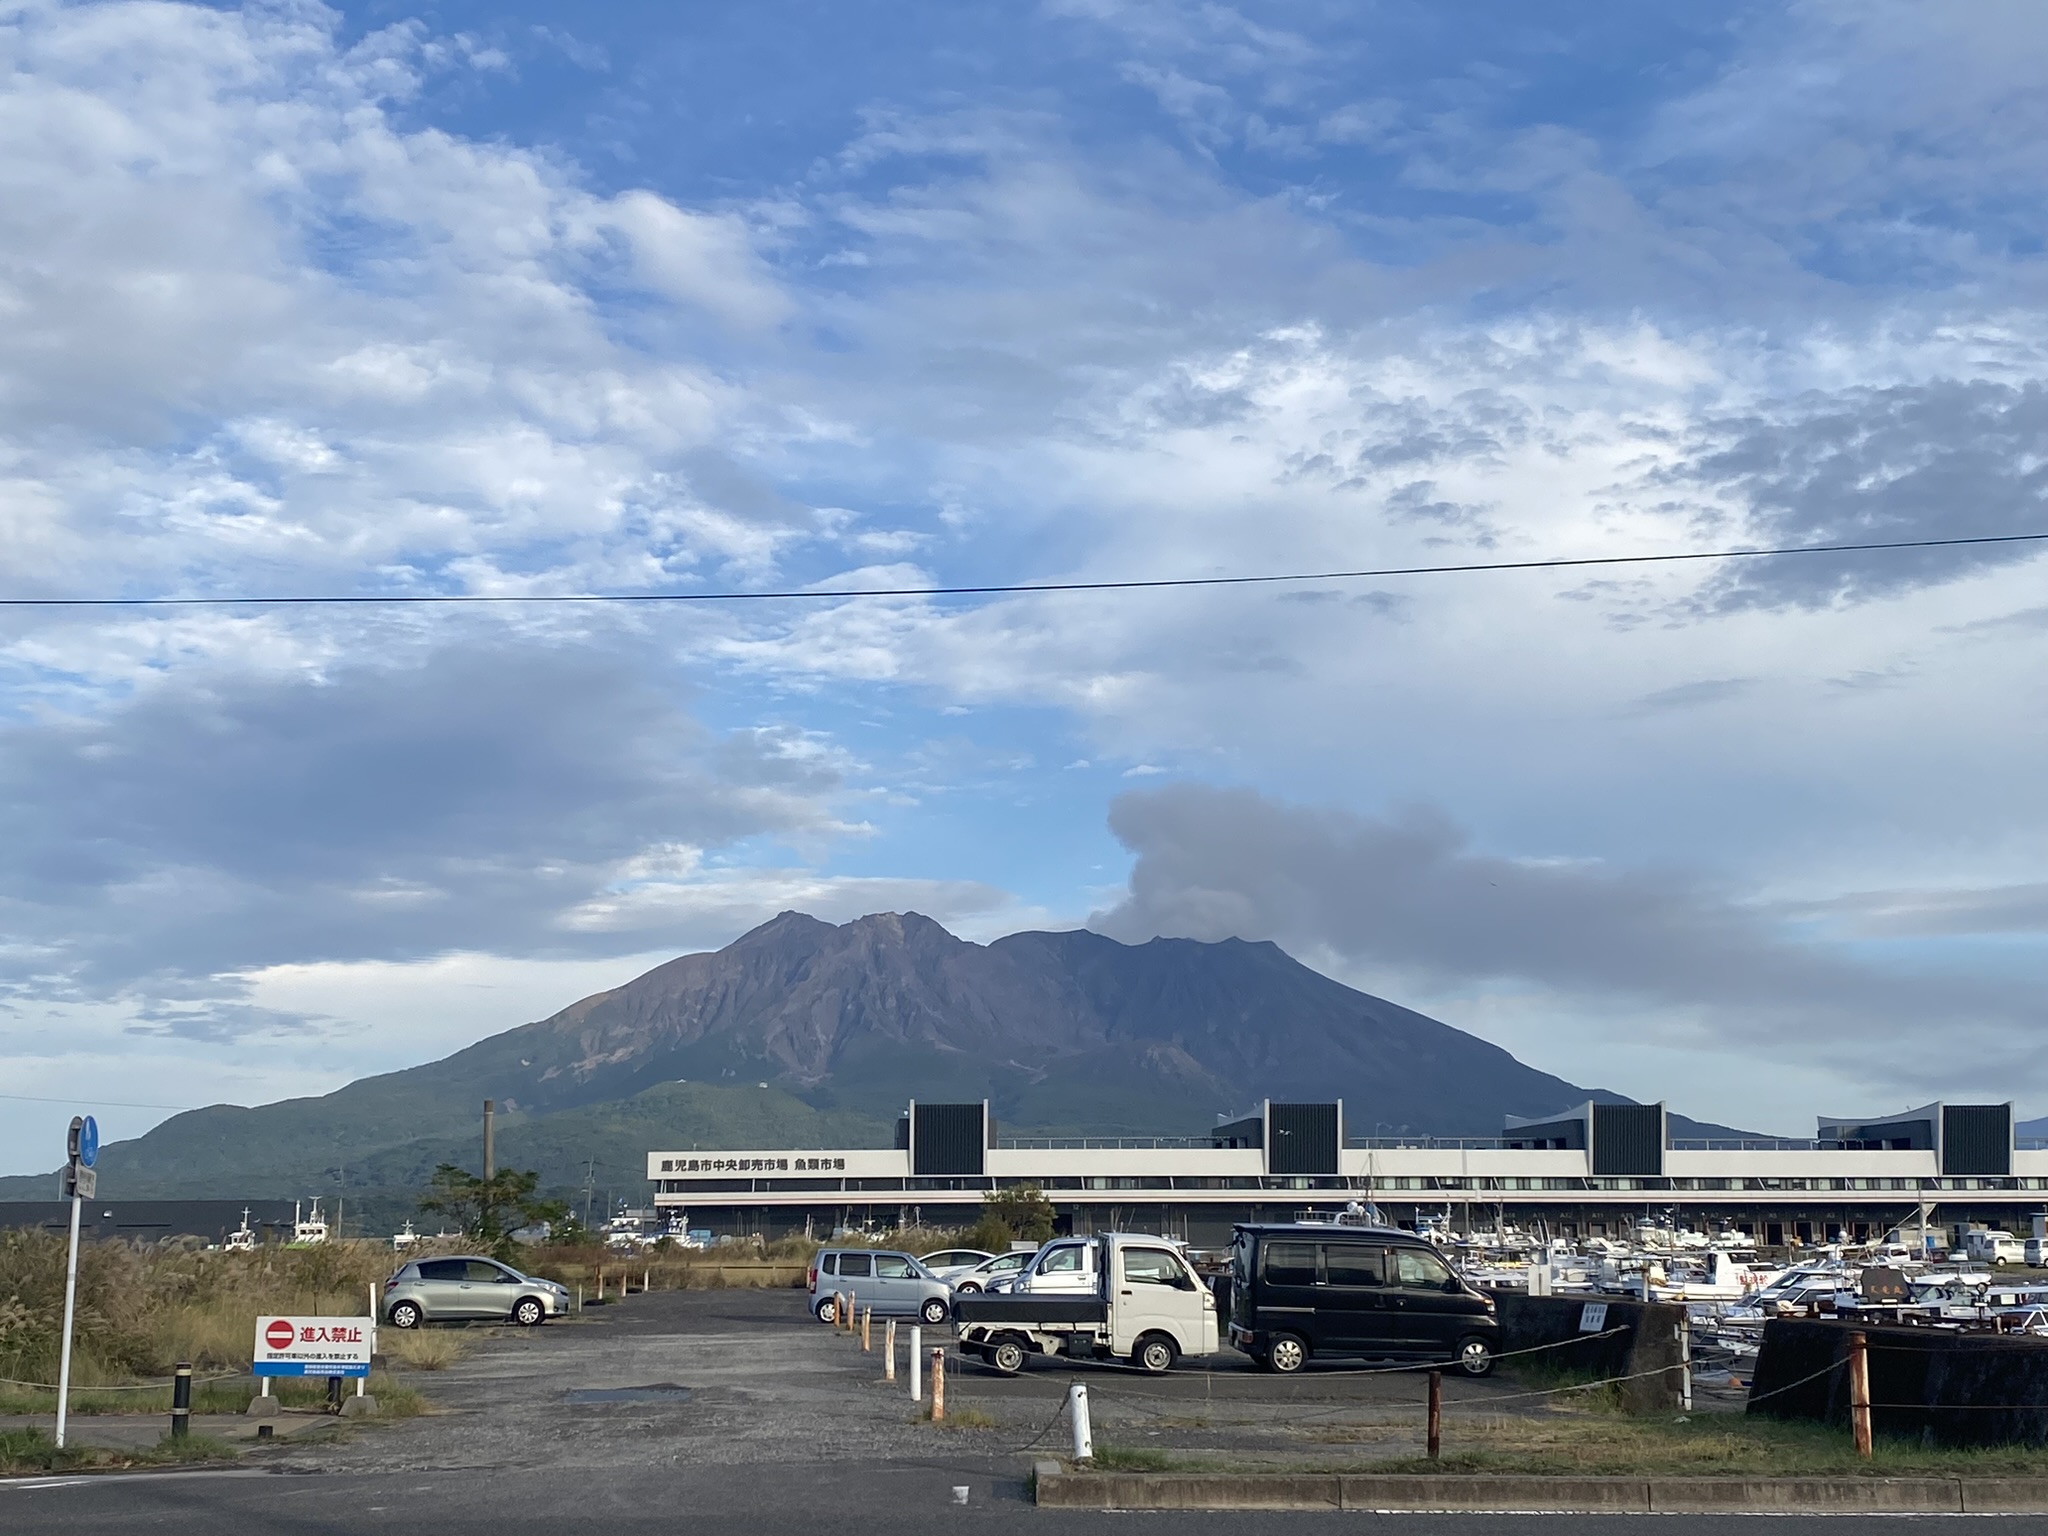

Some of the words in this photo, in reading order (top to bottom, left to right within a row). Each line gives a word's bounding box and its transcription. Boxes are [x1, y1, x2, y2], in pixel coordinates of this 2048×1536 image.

[660, 1158, 789, 1172] 鹿児島市中央卸売市場
[794, 1157, 846, 1171] 魚類市場
[299, 1327, 362, 1342] 進入禁止
